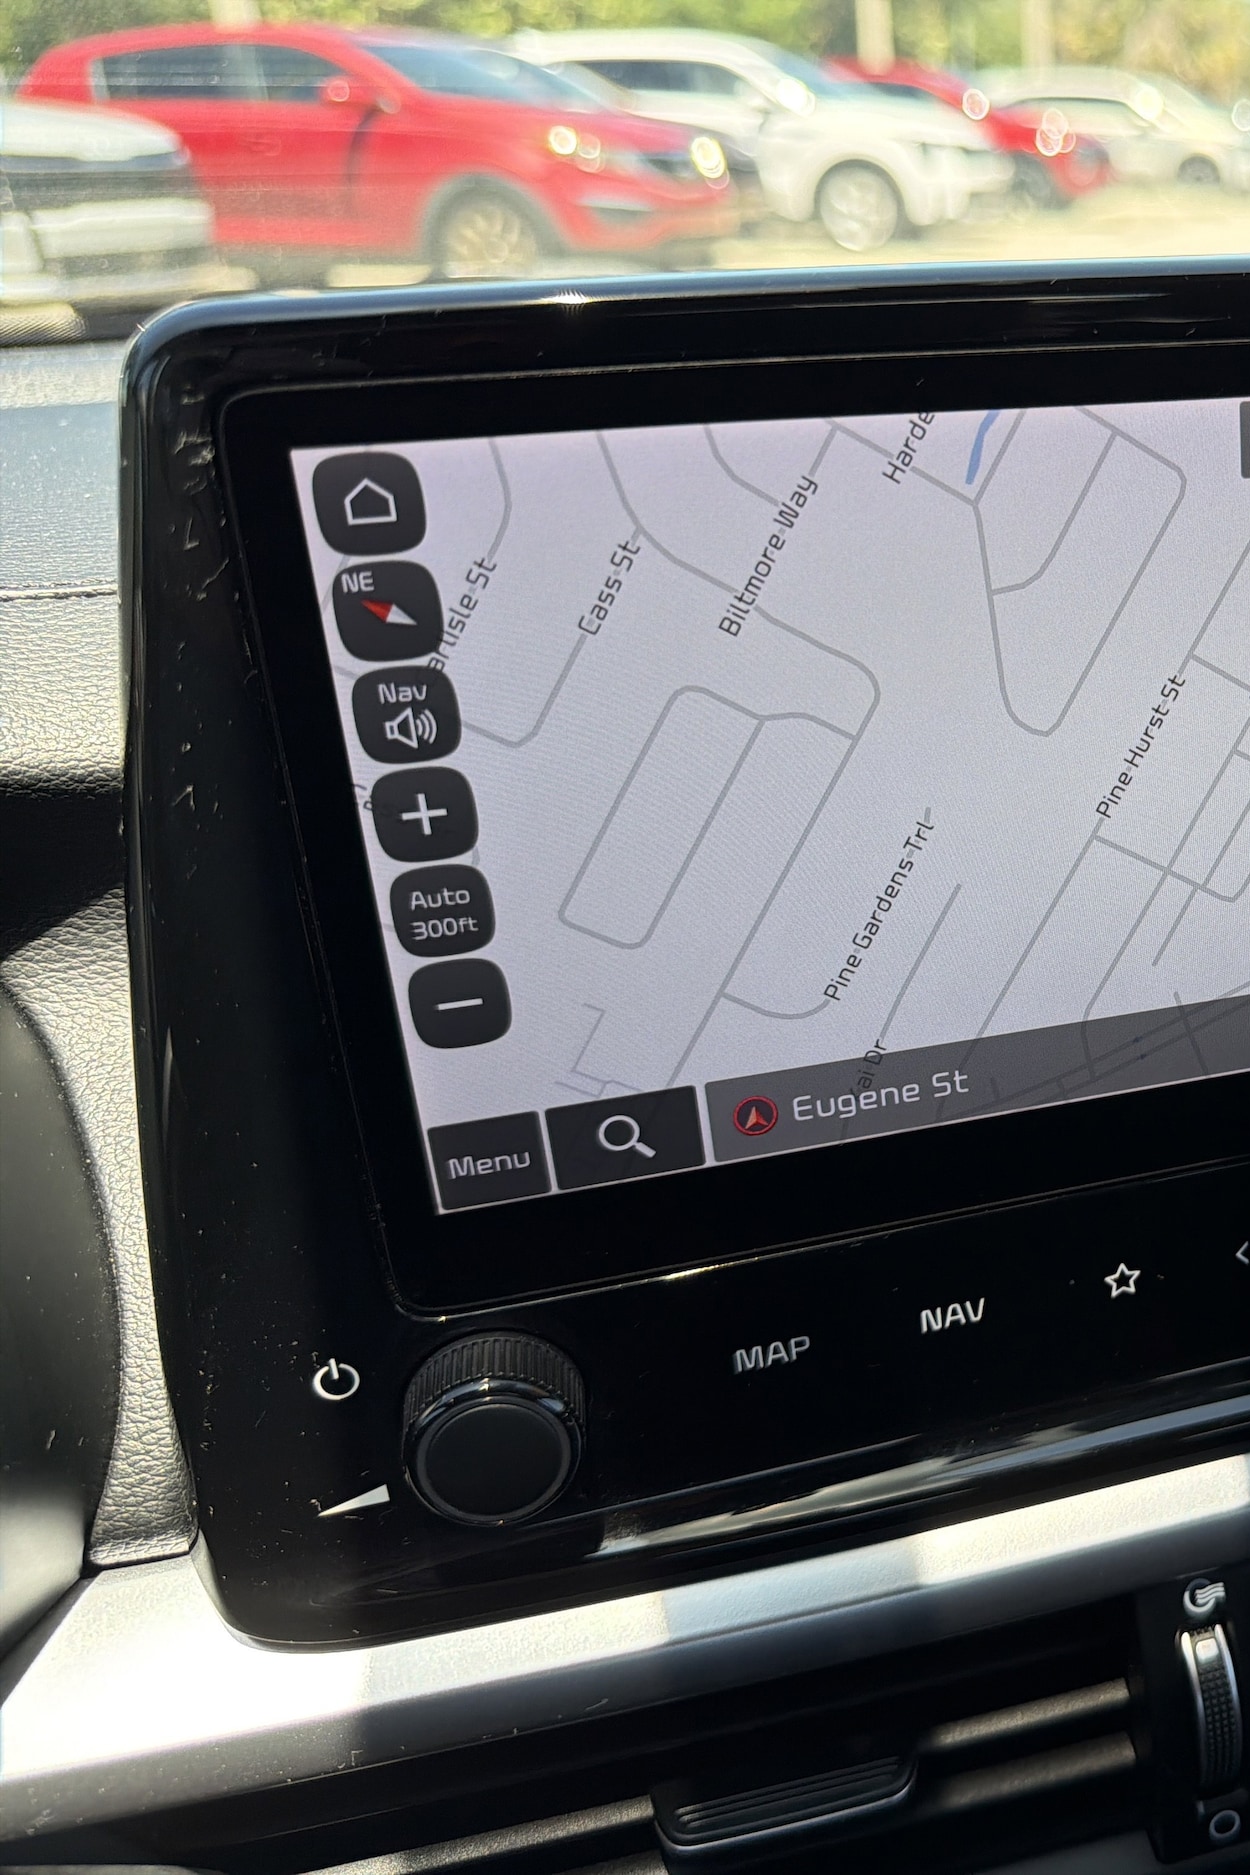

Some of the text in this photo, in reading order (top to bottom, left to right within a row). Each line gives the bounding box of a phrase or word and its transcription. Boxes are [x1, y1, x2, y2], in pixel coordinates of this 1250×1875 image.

[718, 475, 819, 637] Biltmore Way
[341, 571, 375, 594] NE
[577, 540, 642, 636] Cass St
[422, 557, 498, 677] arlisle St
[377, 682, 427, 704] Nav
[1095, 674, 1186, 819] Pine Hurst St
[410, 887, 471, 911] Auto
[823, 821, 934, 1001] Pine Gardens Trl
[411, 916, 480, 941] 300ft
[863, 1038, 887, 1065] Dr
[792, 1070, 970, 1121] Eugene St
[447, 1151, 531, 1180] Menu
[919, 1298, 986, 1334] NAV
[732, 1335, 812, 1375] MAP
